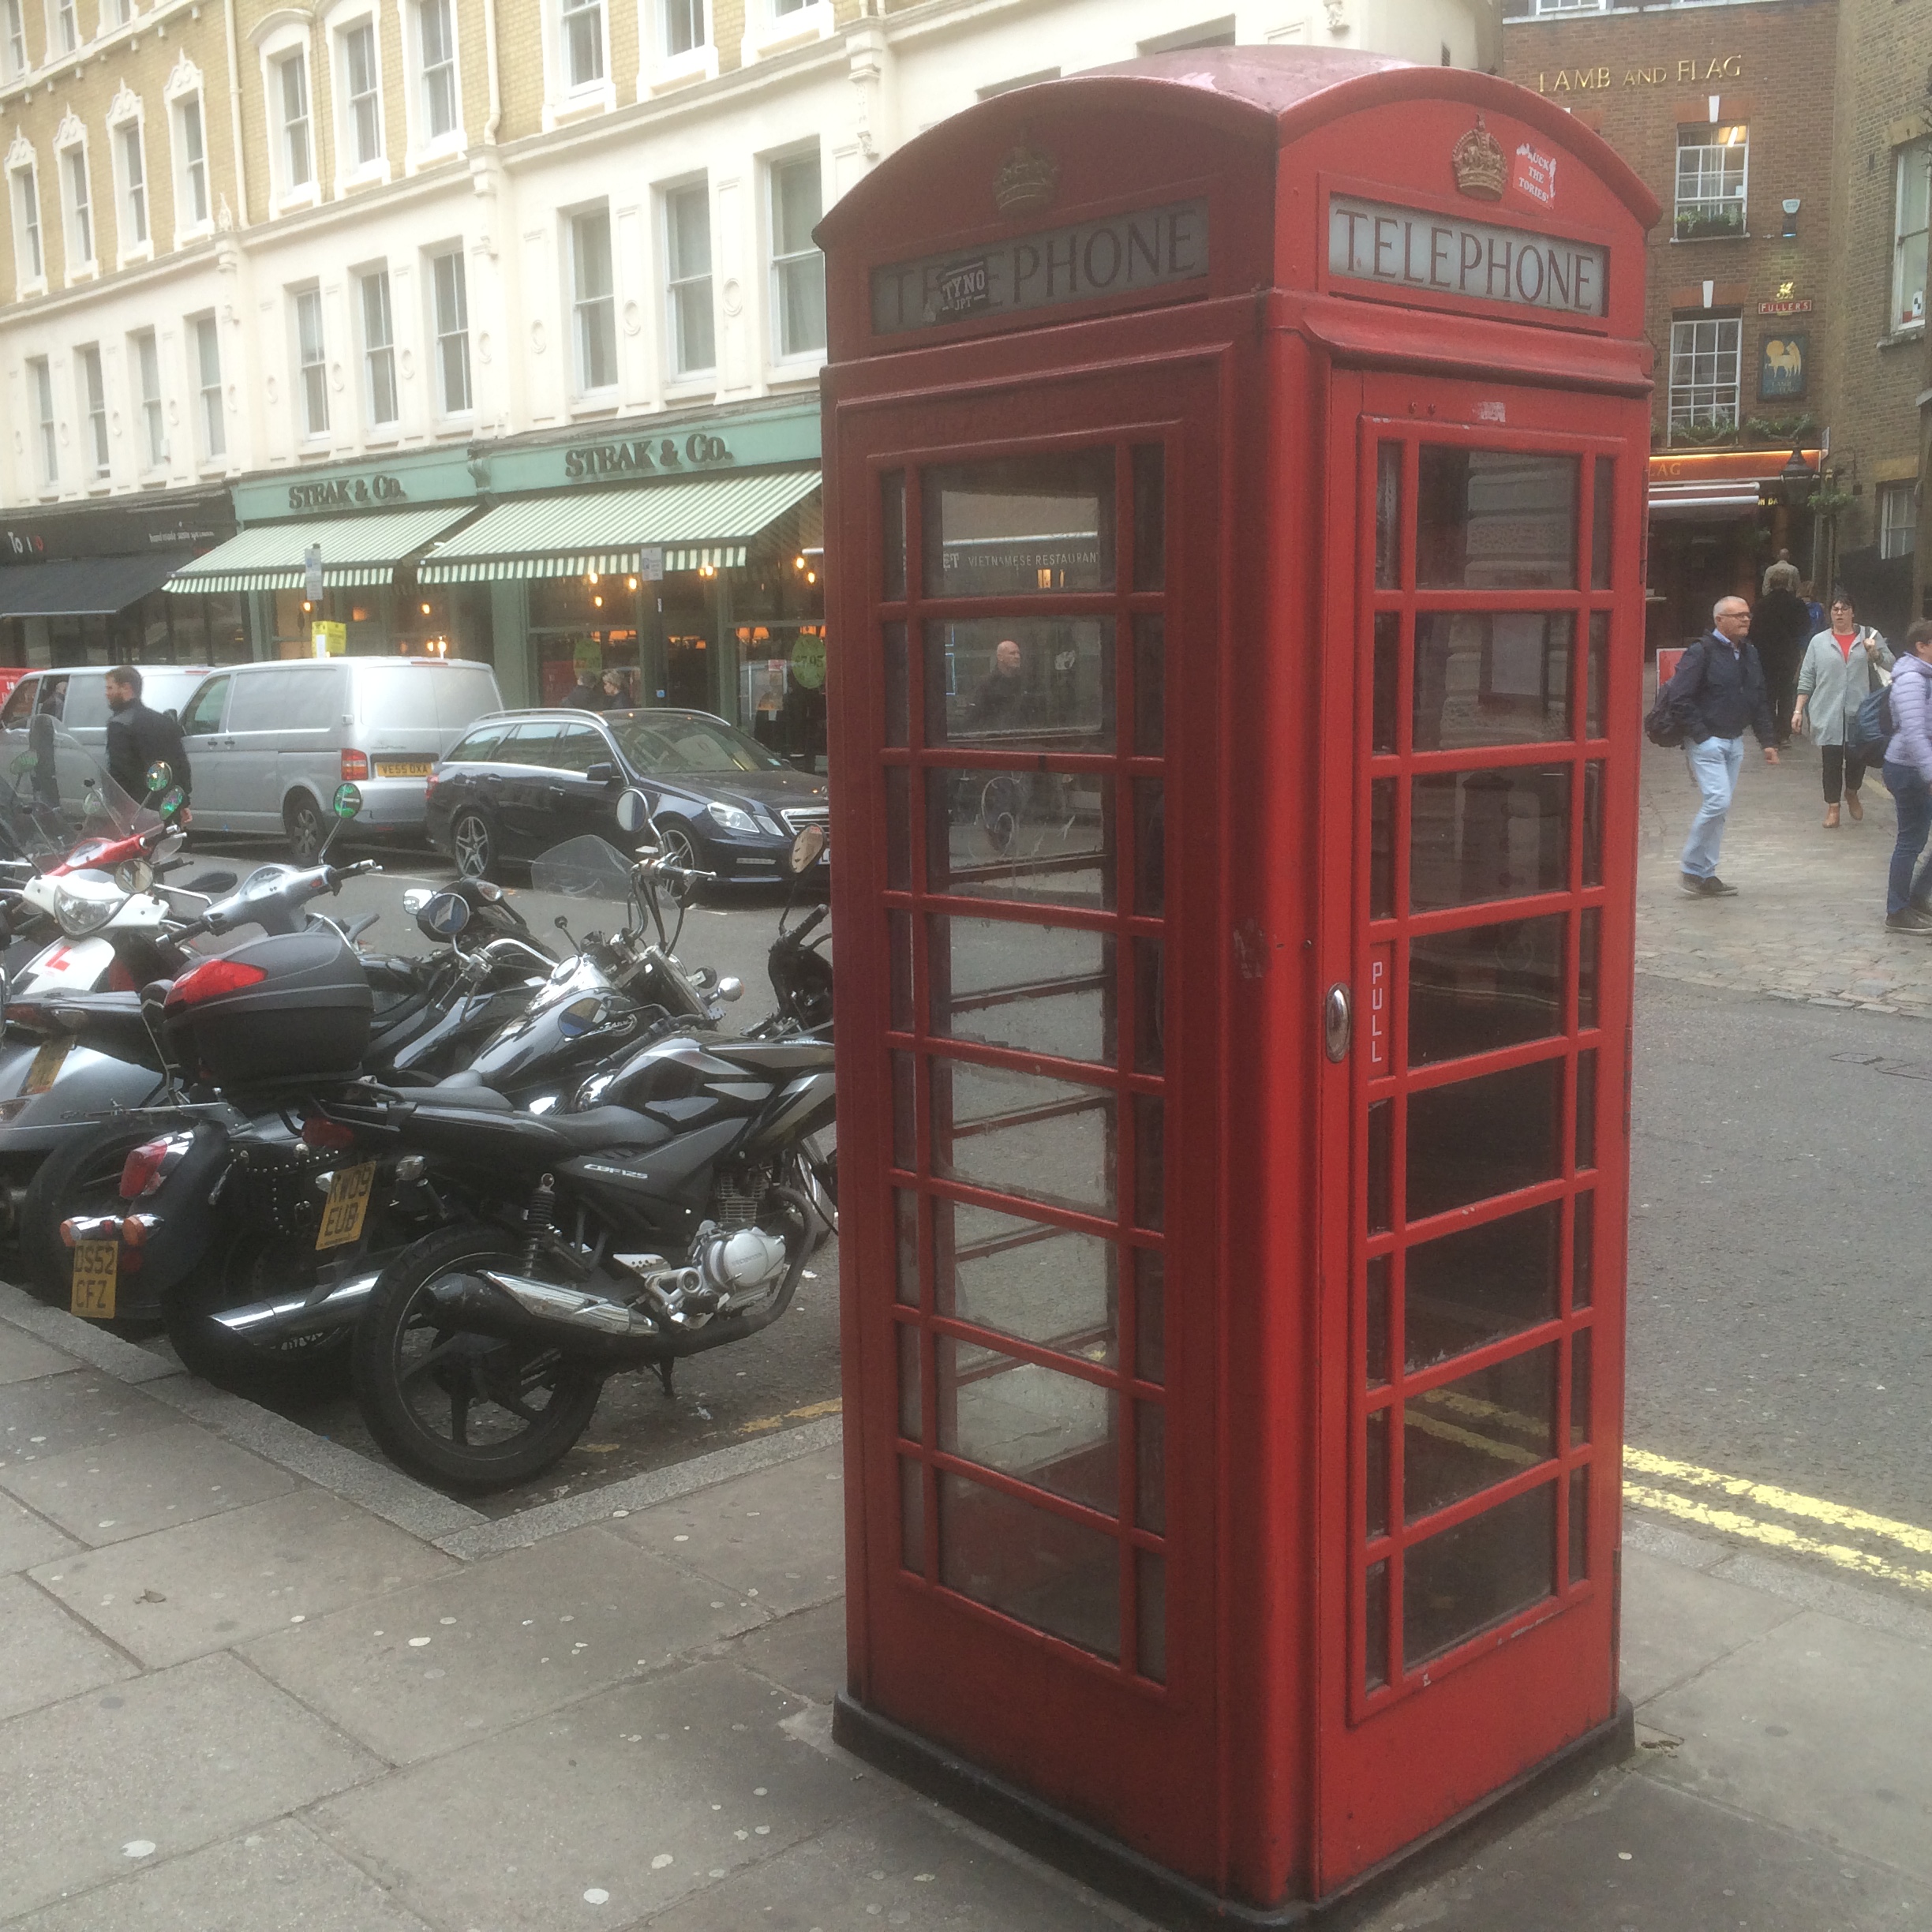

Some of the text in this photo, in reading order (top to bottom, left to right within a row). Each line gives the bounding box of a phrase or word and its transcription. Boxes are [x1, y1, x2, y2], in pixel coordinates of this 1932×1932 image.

[1539, 54, 1742, 92] LAMB AND FLAG
[1529, 166, 1544, 184] THE
[886, 208, 1197, 324] TEEPHONE
[1335, 208, 1594, 311] TELEPHONE
[942, 269, 985, 301] TYNO
[565, 440, 656, 478] STEAK
[660, 440, 683, 467] &
[1649, 462, 1681, 477] AG
[288, 479, 353, 510] STEAK
[355, 478, 372, 502] &
[968, 554, 1032, 567] VIETNAMESE
[1372, 961, 1383, 1063] PULL
